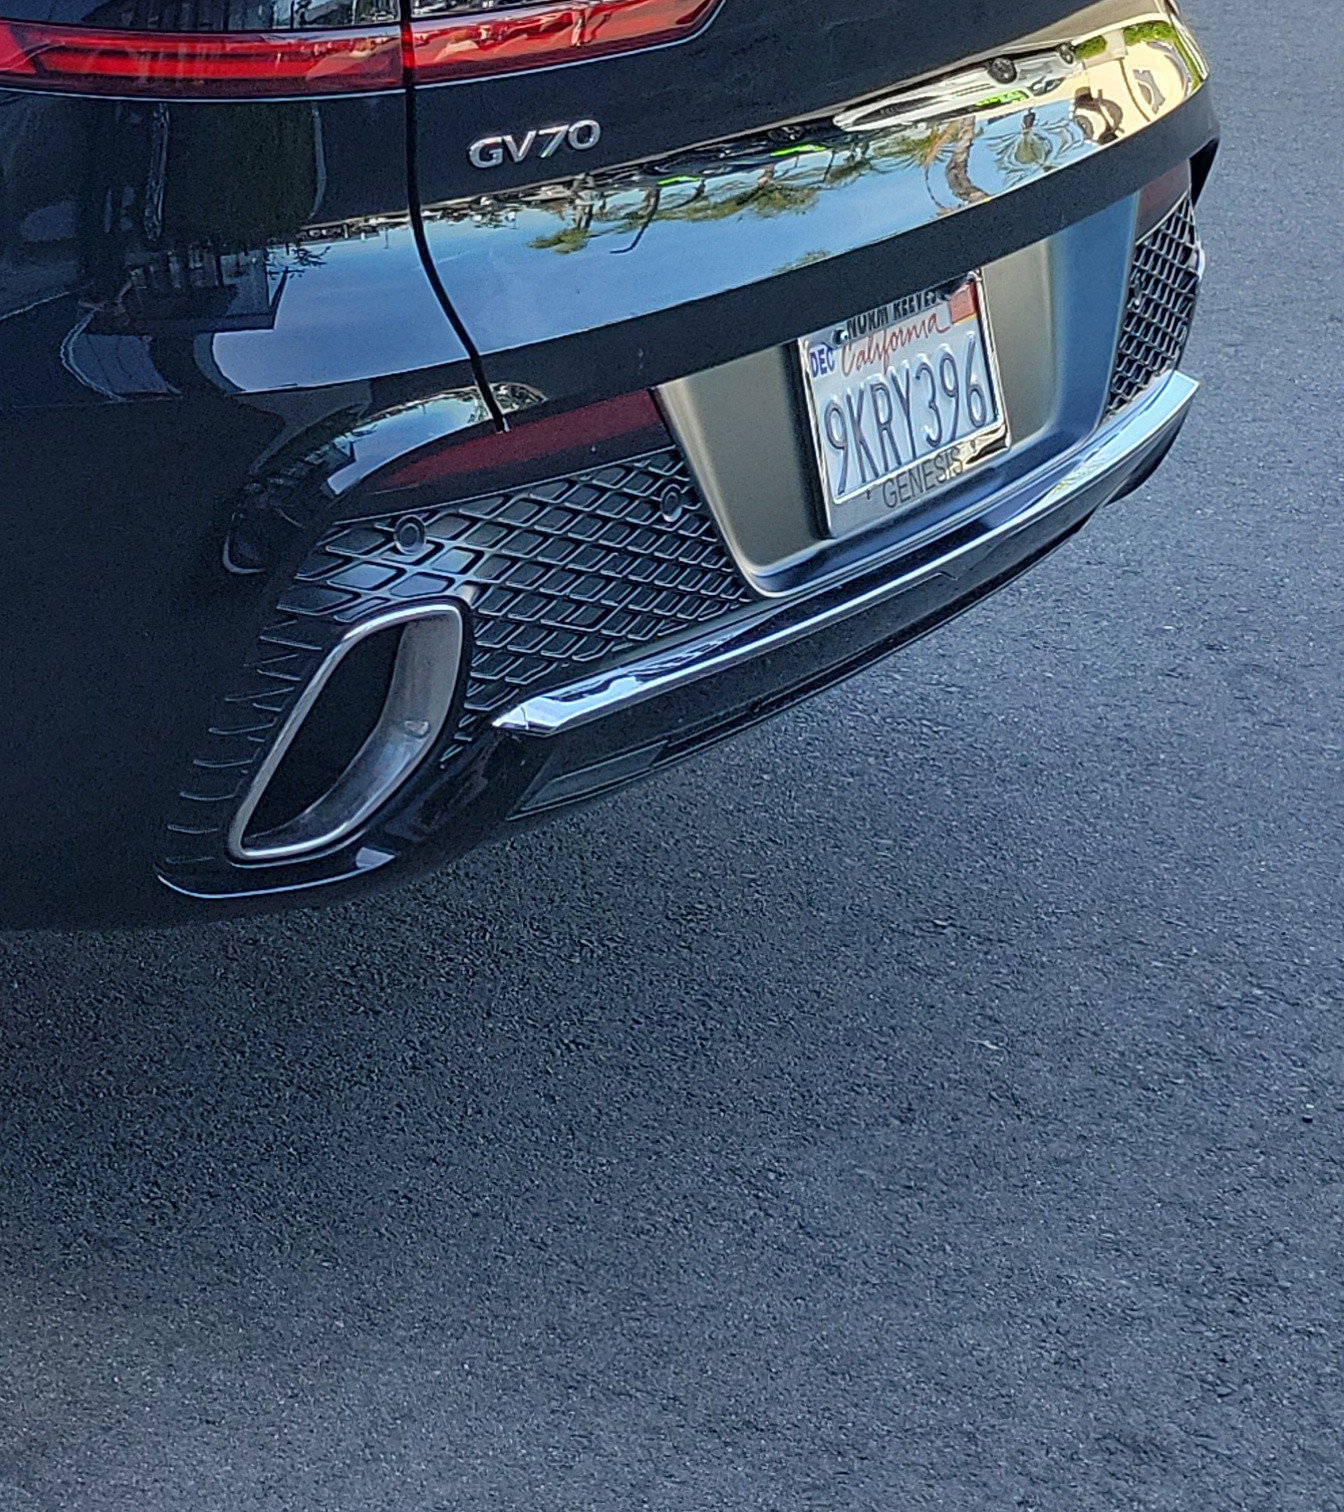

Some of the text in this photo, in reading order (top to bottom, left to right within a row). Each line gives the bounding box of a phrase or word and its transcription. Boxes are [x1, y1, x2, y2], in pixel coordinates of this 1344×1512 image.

[469, 119, 602, 169] GV70
[811, 349, 836, 378] DEC
[840, 312, 951, 378] California
[823, 336, 988, 496] 9KRY396
[880, 445, 965, 509] GENESIS
